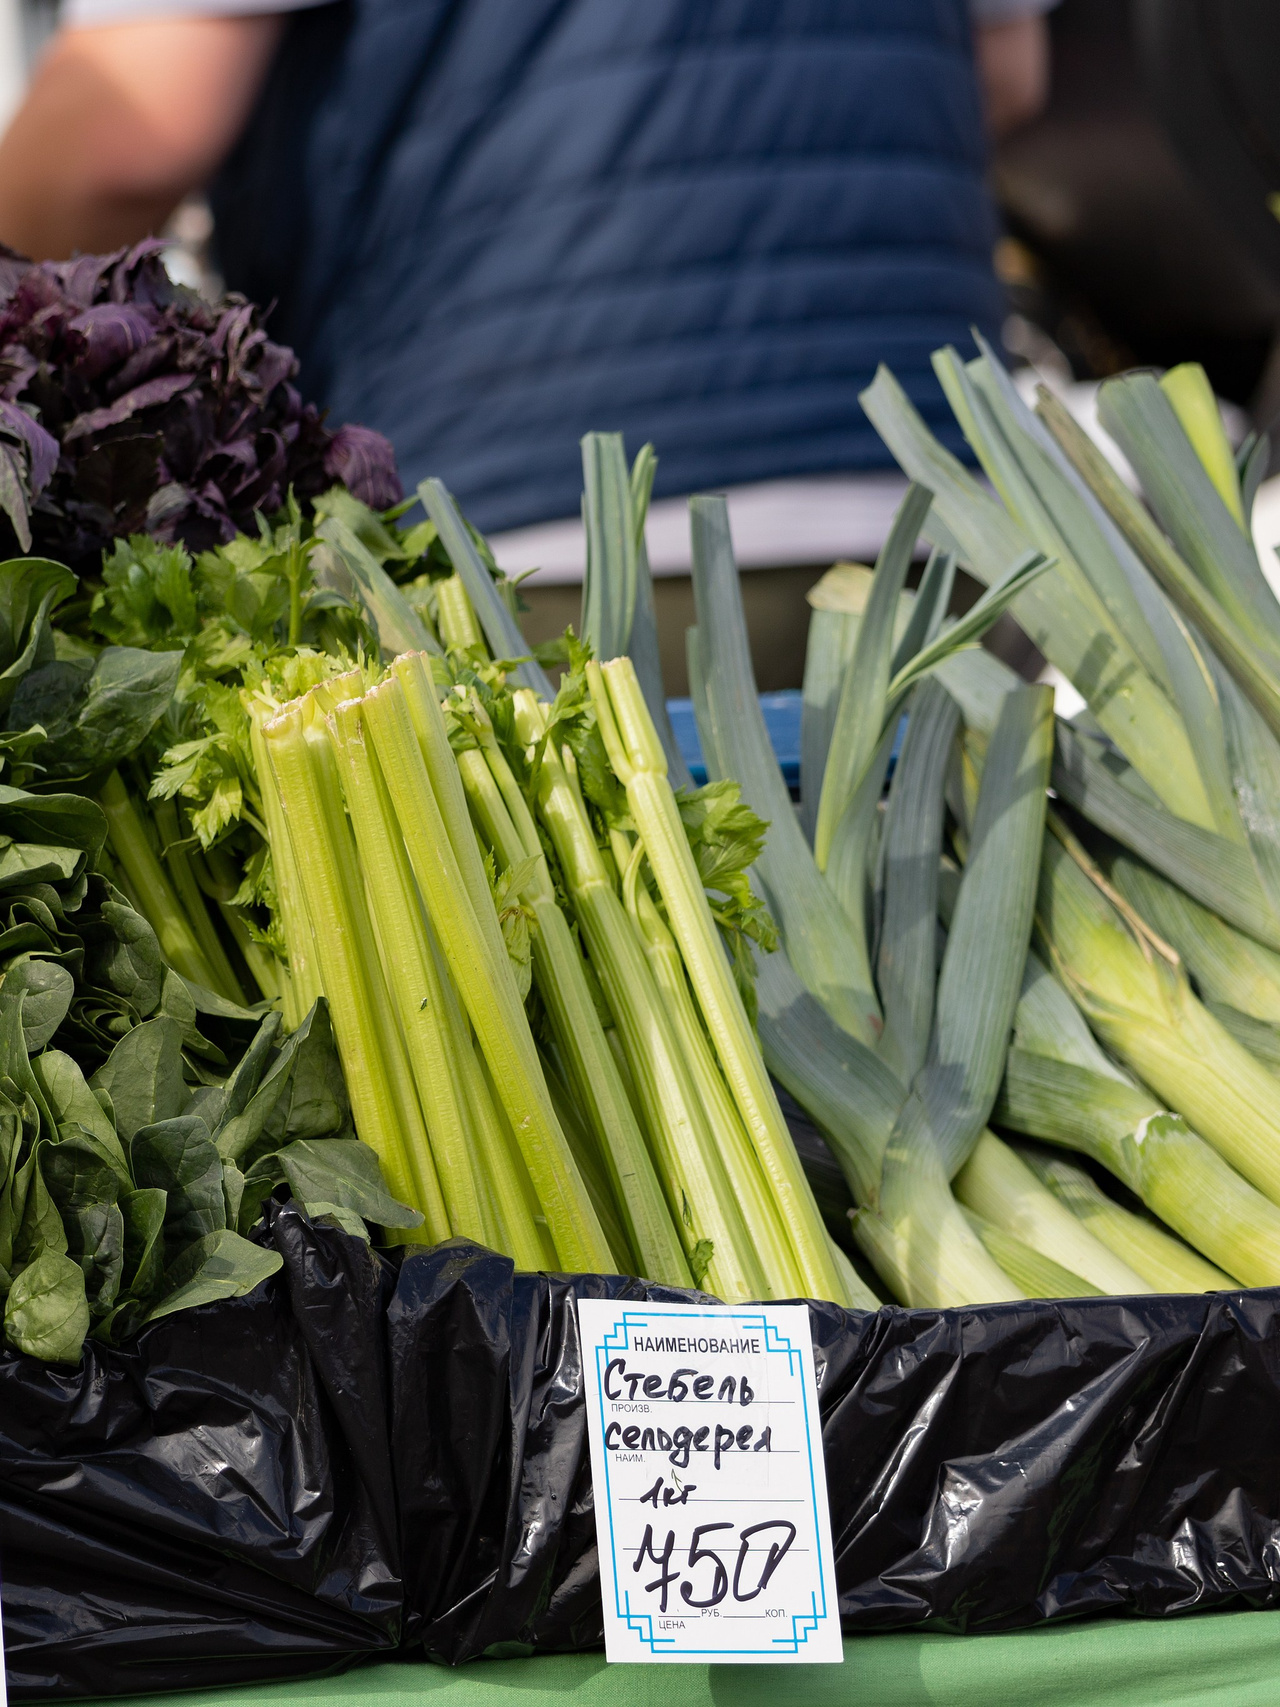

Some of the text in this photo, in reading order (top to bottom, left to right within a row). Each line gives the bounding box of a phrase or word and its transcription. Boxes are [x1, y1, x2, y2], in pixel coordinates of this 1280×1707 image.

[633, 1336, 761, 1354] НАИМЕНОВАНИЕ
[604, 1358, 755, 1407] Стебель
[611, 1403, 653, 1413] ПРОИЗВ.
[615, 1453, 646, 1463] НАИМ.
[633, 1520, 796, 1613] 750
[701, 1608, 788, 1618] РУБ. КОП.
[658, 1620, 686, 1630] ЦЕНА
